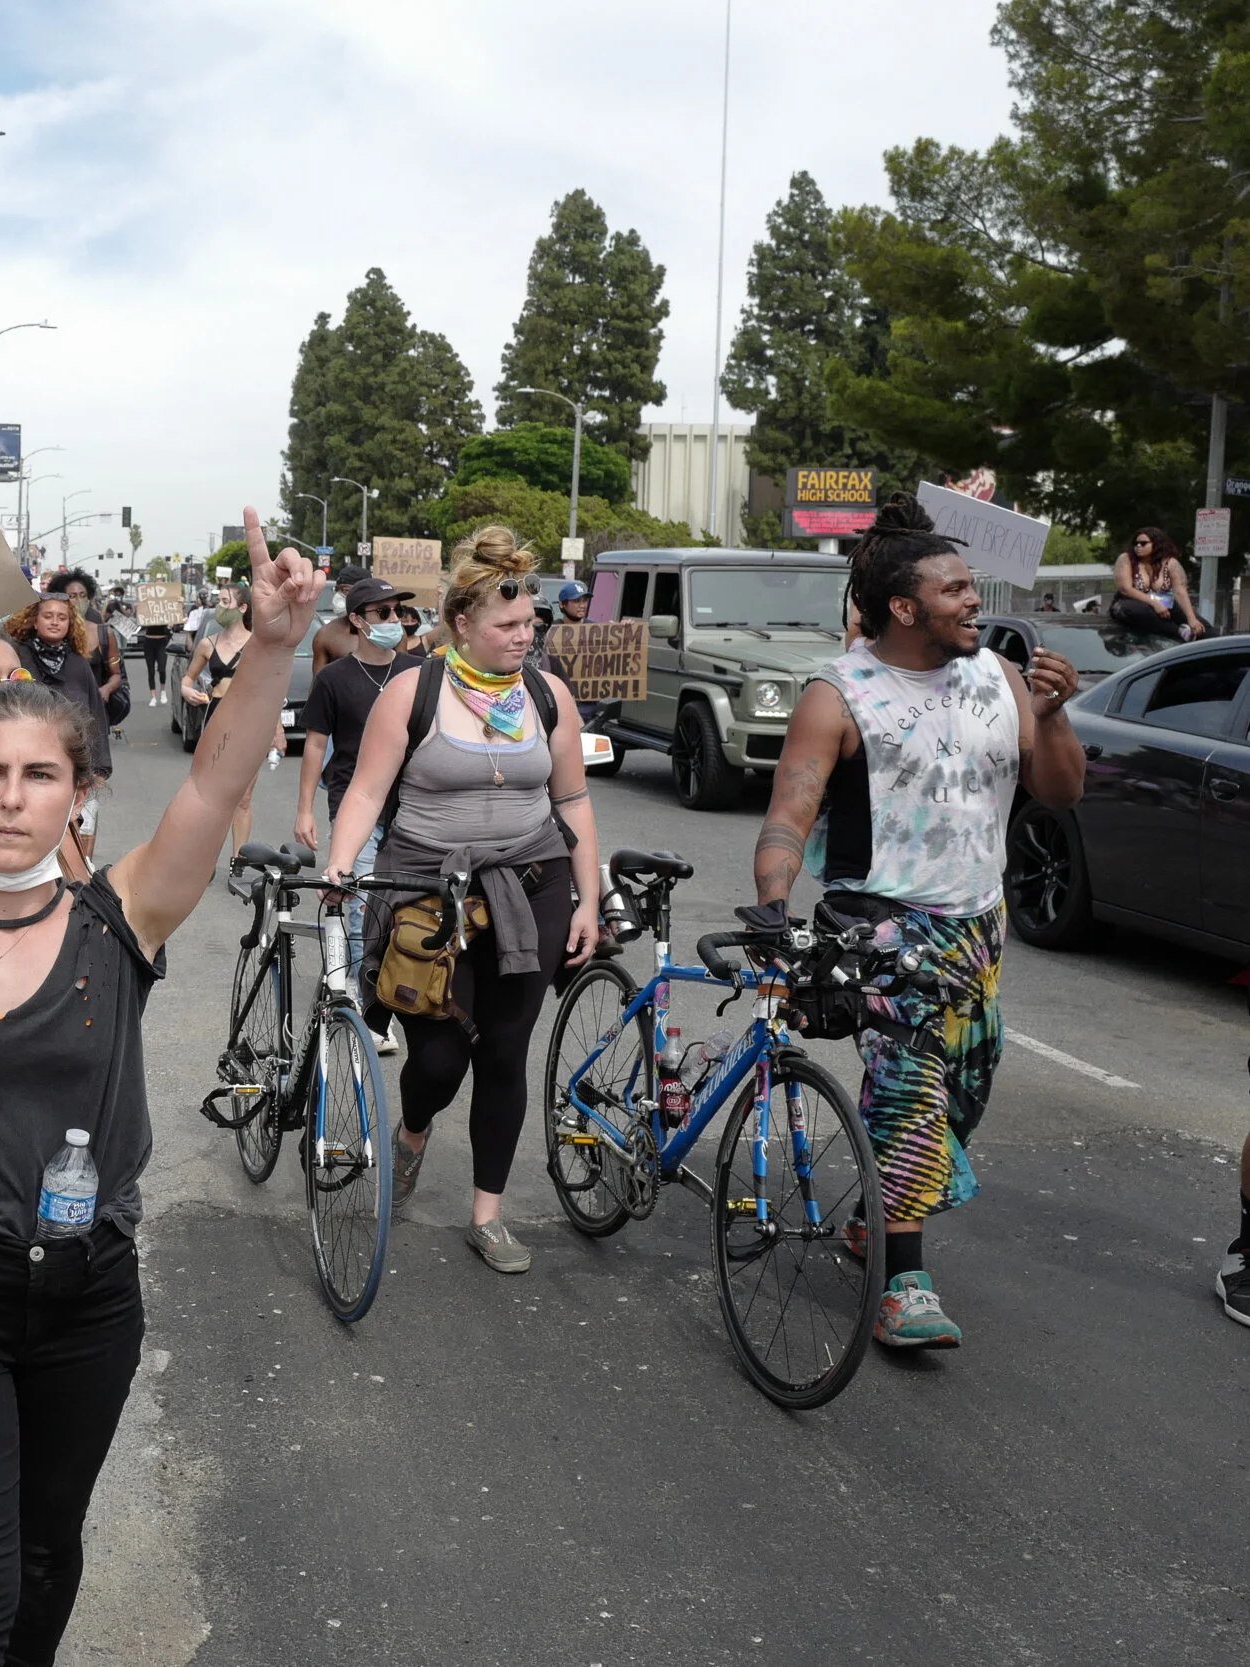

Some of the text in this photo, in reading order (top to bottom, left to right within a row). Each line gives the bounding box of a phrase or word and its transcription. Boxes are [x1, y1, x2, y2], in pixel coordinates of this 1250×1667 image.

[797, 470, 873, 490] FAIRFAX
[797, 490, 872, 503] HIGH SCHOOL
[137, 584, 167, 602] END
[561, 624, 643, 655] RACISM
[580, 652, 642, 679] HOMIES
[880, 693, 1000, 750] Peaceful
[933, 736, 963, 760] As
[886, 748, 1007, 805] Fuck
